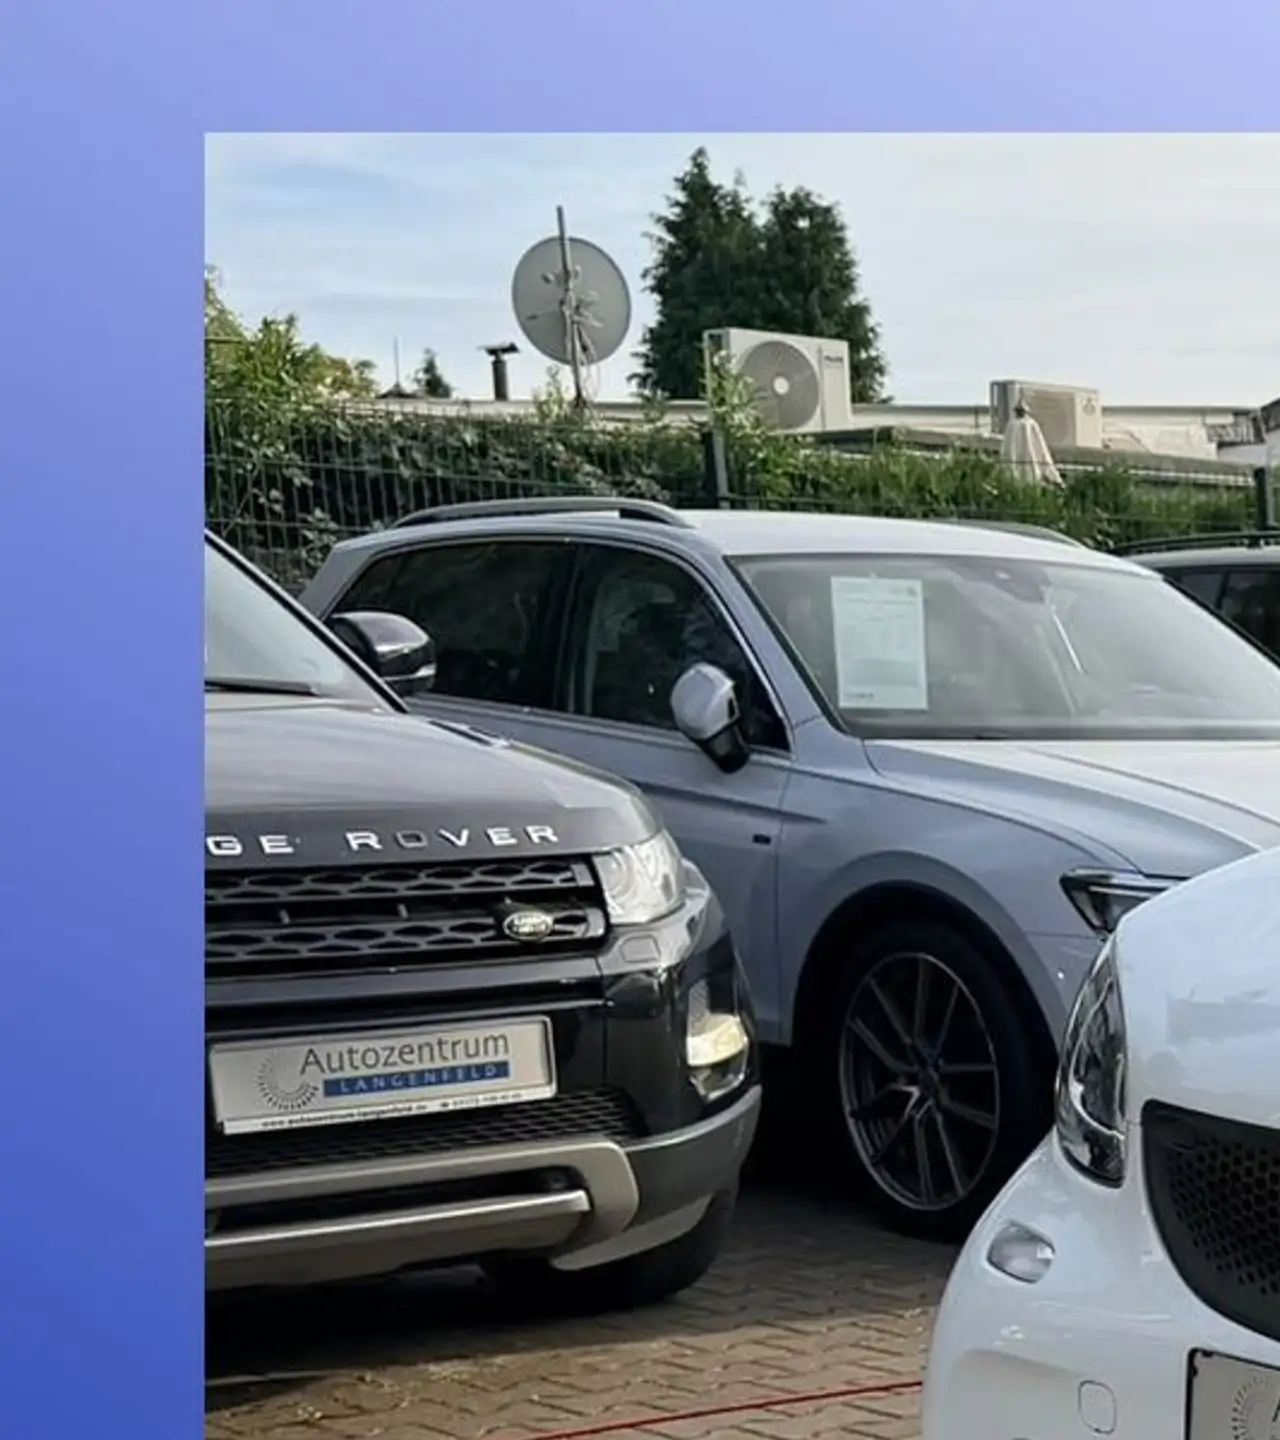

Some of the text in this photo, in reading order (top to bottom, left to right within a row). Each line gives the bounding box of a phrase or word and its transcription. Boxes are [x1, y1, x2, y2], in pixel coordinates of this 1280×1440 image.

[346, 825, 559, 851] ROVER
[300, 1033, 509, 1076] Autozentrum
[340, 1065, 498, 1094] LANGENFELD
